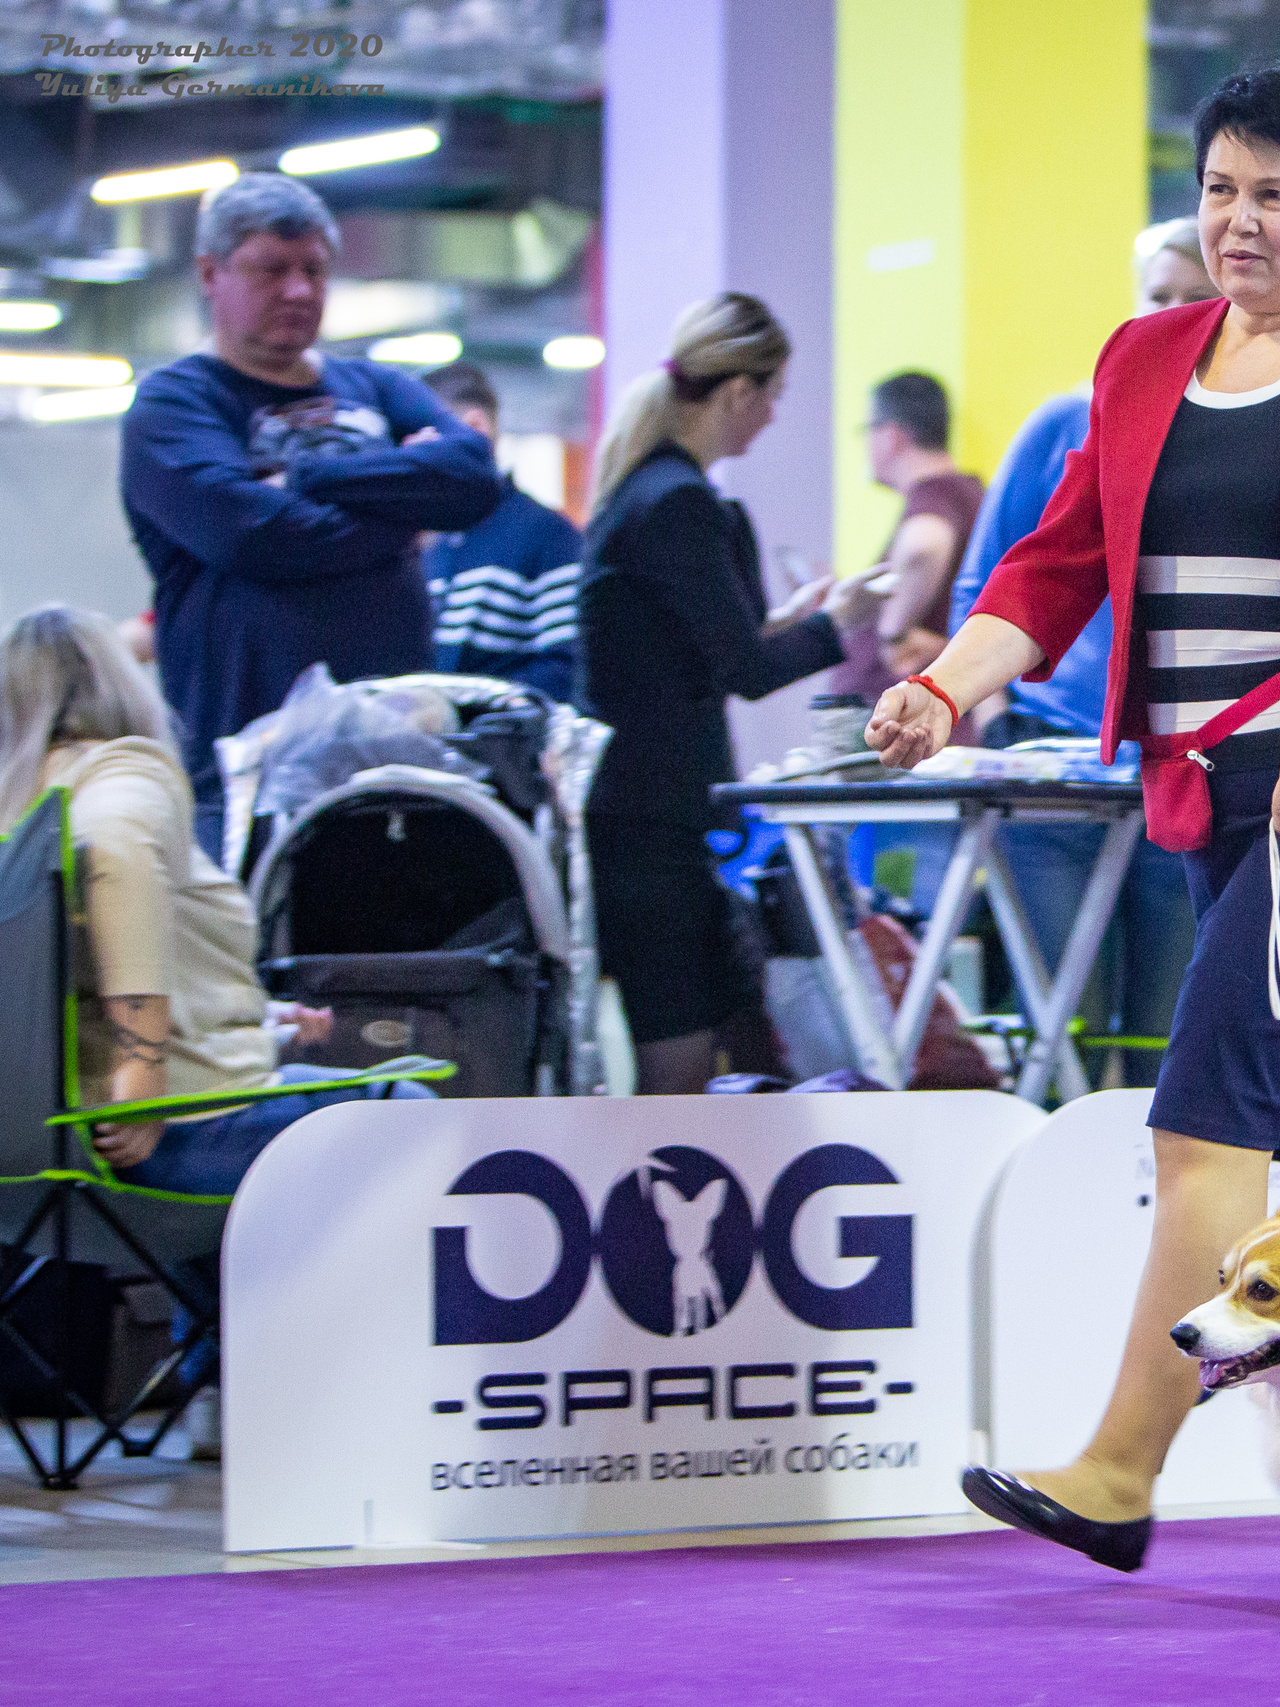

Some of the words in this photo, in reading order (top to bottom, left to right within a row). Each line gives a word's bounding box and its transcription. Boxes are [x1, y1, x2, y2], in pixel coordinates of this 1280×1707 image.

[431, 1143, 914, 1346] DOG
[431, 1453, 642, 1491] вселенная
[649, 1437, 777, 1481] вашей
[784, 1432, 918, 1475] собаки
